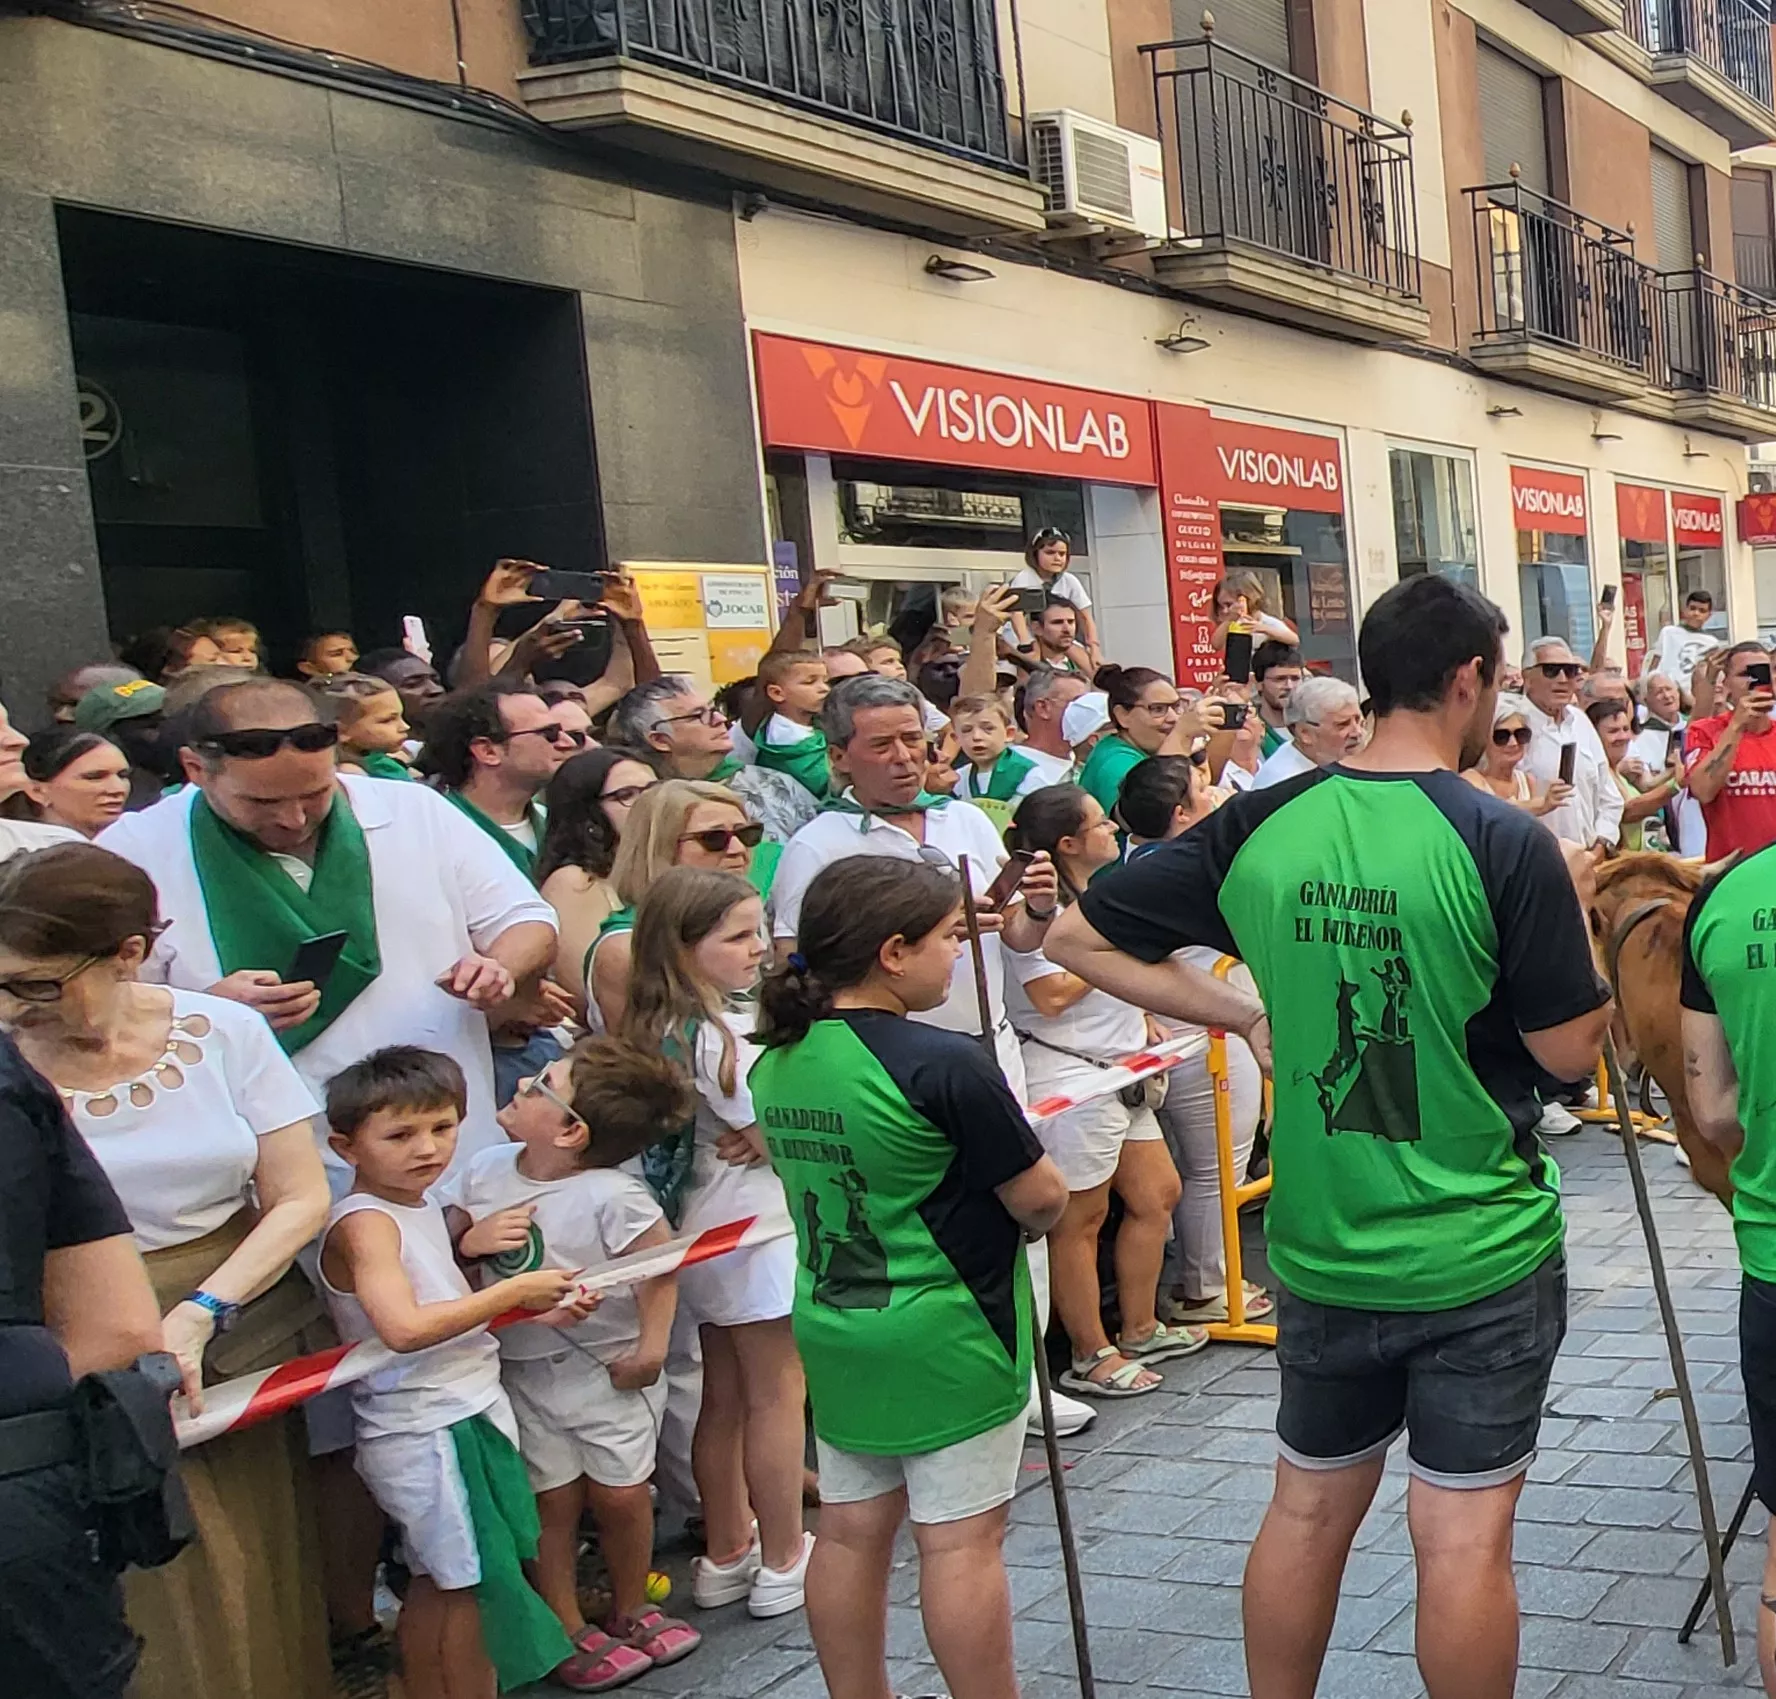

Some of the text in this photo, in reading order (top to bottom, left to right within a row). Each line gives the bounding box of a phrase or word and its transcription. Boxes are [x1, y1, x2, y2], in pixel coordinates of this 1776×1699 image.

[889, 381, 1130, 459] VISIONLAB
[1216, 446, 1338, 491] VISIONLAB
[1512, 485, 1584, 517] VISIONLAB
[1672, 508, 1721, 532] VISIONLAB
[723, 604, 764, 614] JOCAR
[1192, 643, 1216, 654] TOU
[1300, 881, 1398, 916] GANADERÍA
[1295, 918, 1315, 942] EL
[1746, 943, 1767, 969] EL
[764, 1105, 845, 1135] GANADERÍA
